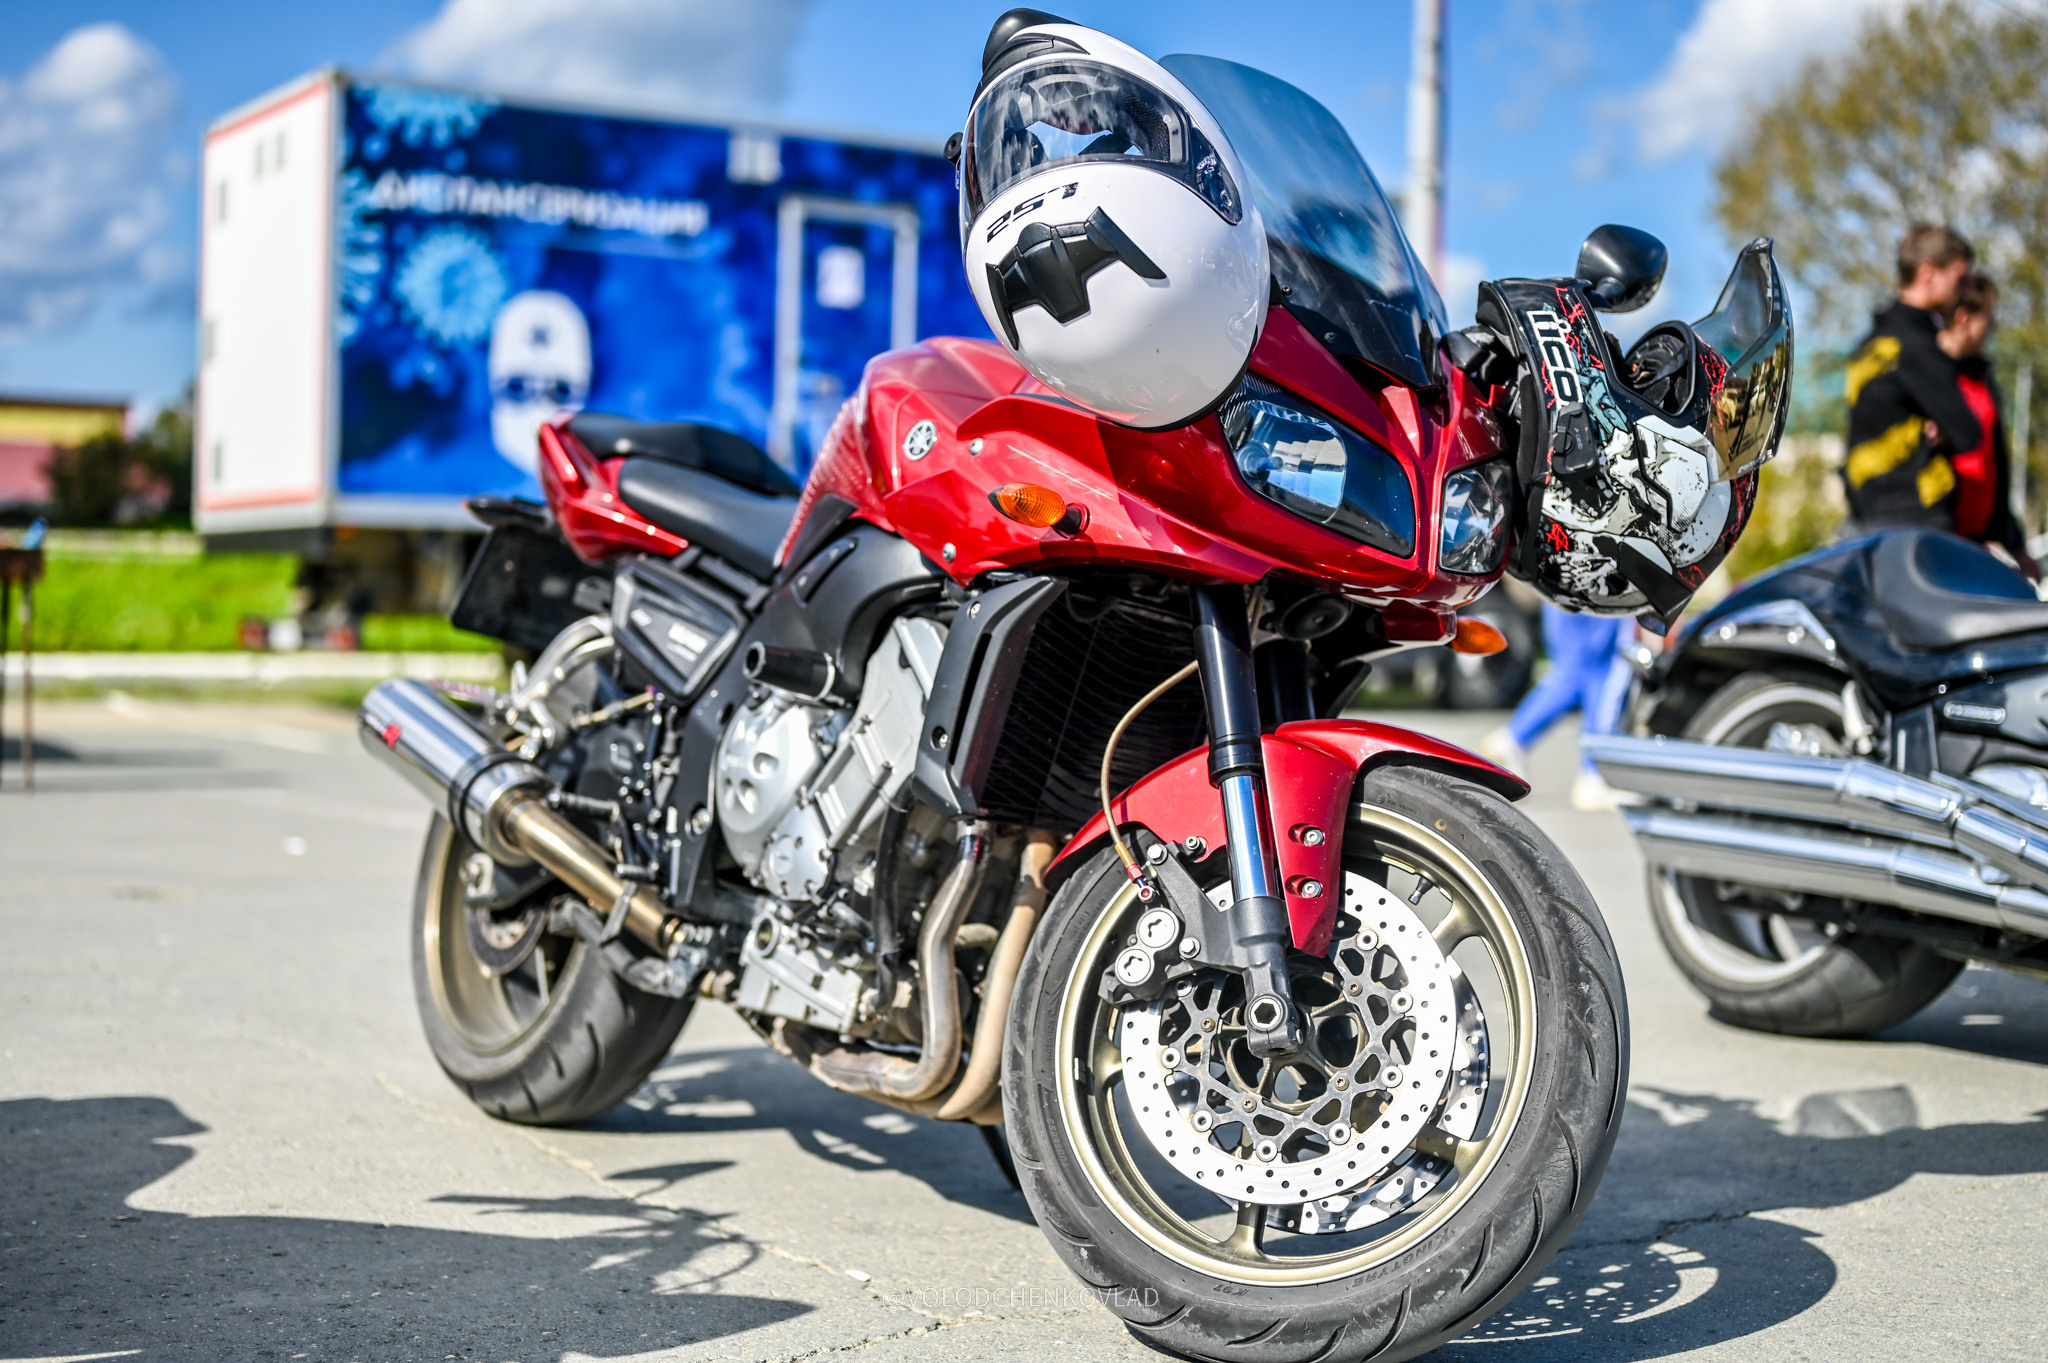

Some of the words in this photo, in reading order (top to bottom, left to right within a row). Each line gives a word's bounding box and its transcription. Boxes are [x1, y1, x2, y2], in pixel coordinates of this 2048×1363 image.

[1514, 902, 1536, 941] RADIAL
[1046, 1117, 1070, 1169] TUBELESS
[1351, 1227, 1451, 1289] KINGTYRE
